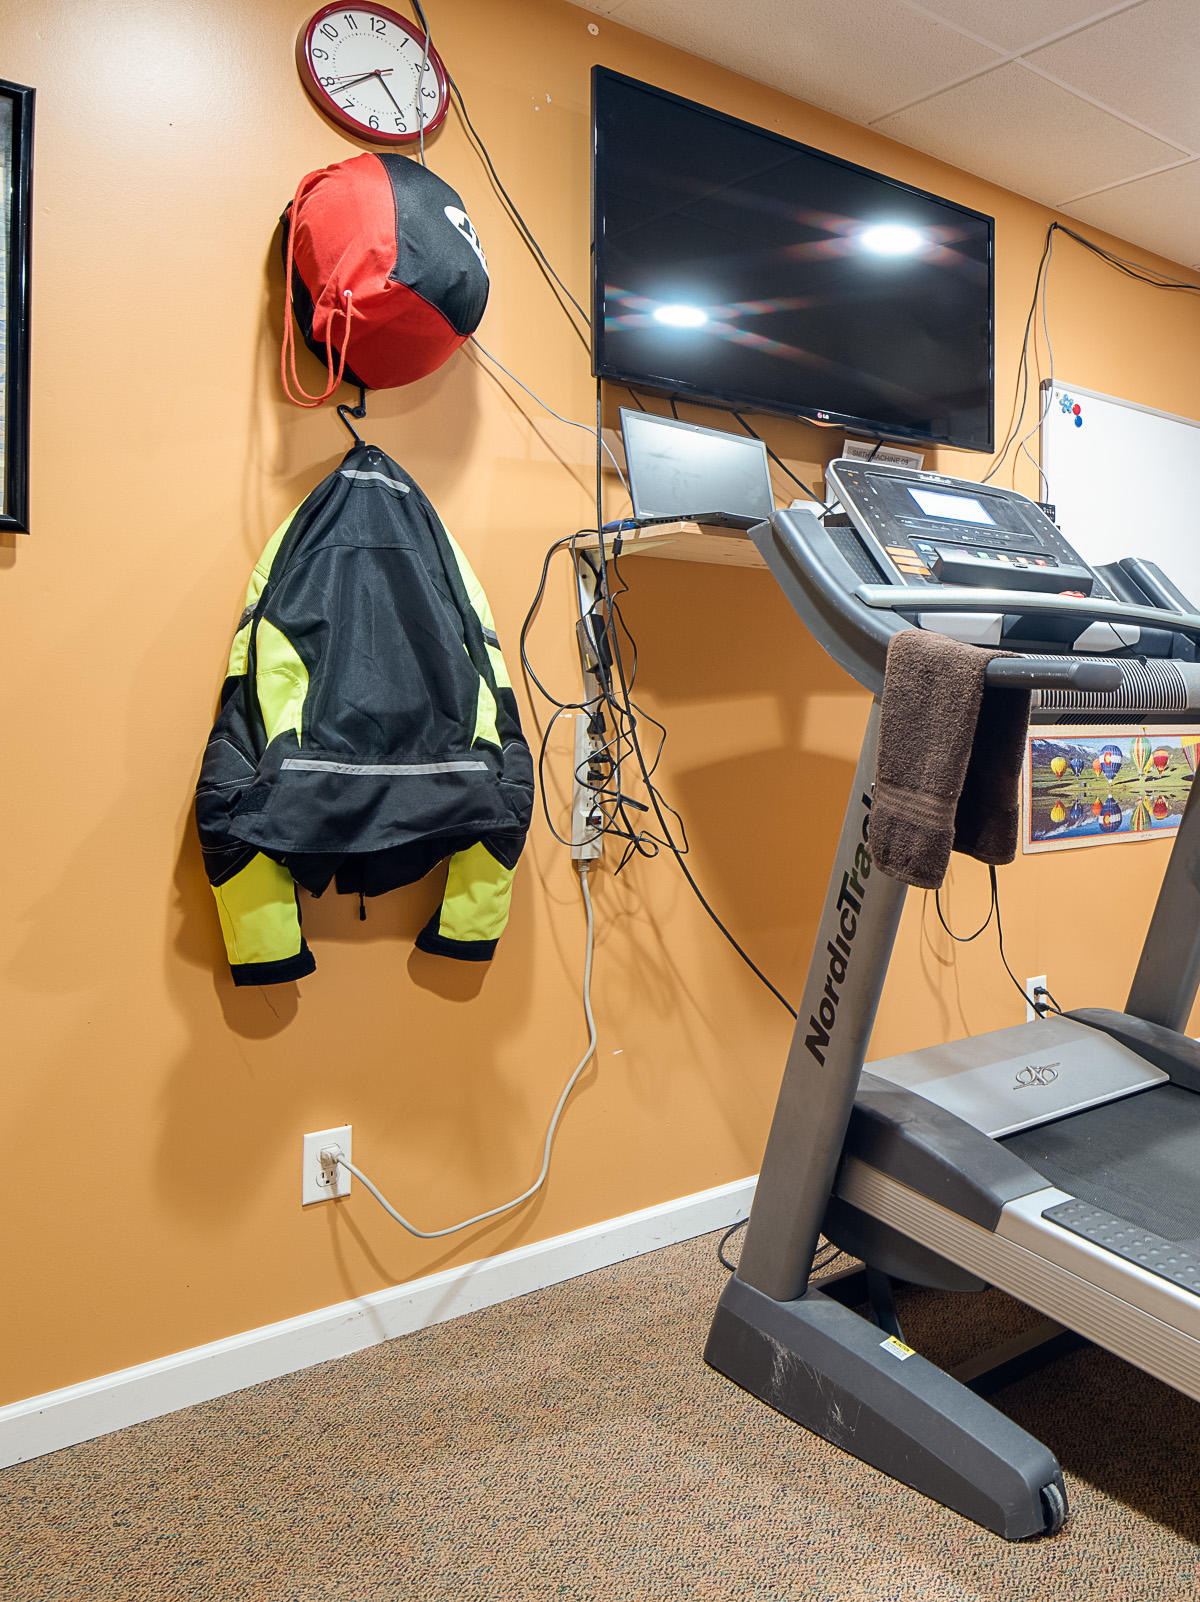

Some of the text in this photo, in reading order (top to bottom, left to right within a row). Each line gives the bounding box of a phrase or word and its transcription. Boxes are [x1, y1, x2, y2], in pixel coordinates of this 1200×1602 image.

[343, 13, 358, 30] 11
[369, 16, 386, 36] 12
[319, 23, 339, 42] 10
[400, 37, 410, 48] 1
[312, 48, 329, 61] 9
[414, 62, 430, 73] 2
[319, 76, 335, 88] 8
[421, 87, 436, 99] 3
[341, 98, 355, 110] 7
[415, 106, 429, 119] 4
[368, 115, 379, 130] 6
[394, 117, 407, 133] 5
